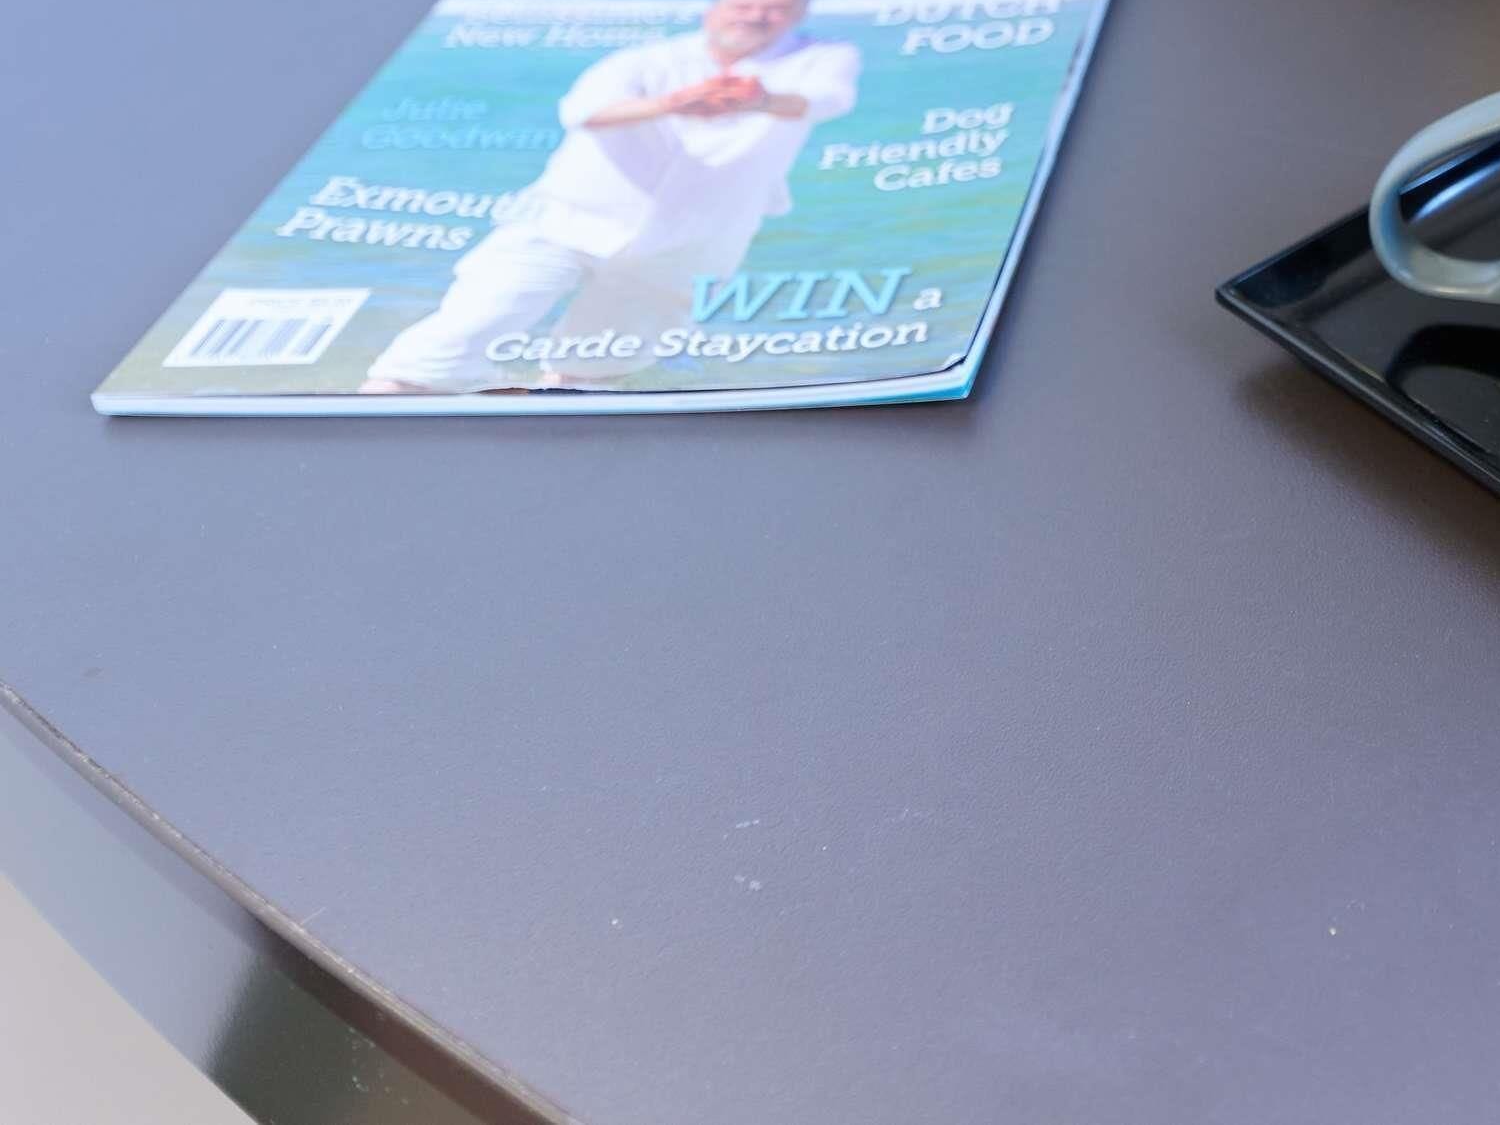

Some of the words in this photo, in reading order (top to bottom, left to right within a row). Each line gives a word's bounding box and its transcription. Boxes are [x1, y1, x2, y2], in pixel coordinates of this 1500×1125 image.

[900, 15, 1056, 56] FOOD
[921, 101, 1014, 135] Dog
[818, 128, 1010, 171] Friendly
[872, 155, 1003, 192] Cafes
[274, 204, 476, 252] Prawns
[690, 266, 914, 323] WIN
[912, 286, 942, 312] a
[484, 329, 642, 362] Garde
[652, 318, 930, 364] Staycation
